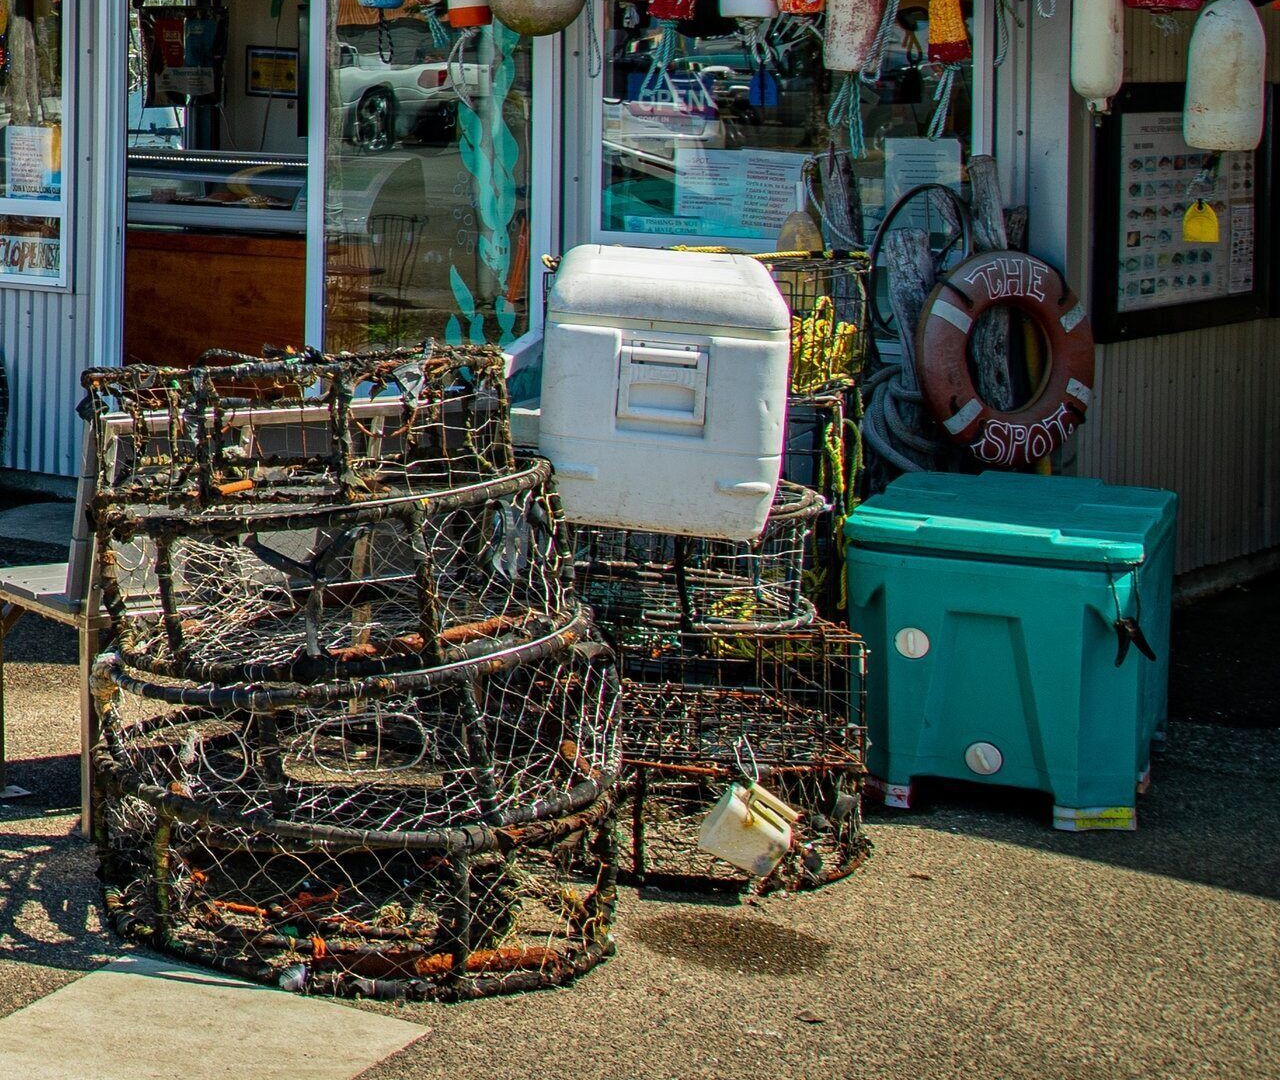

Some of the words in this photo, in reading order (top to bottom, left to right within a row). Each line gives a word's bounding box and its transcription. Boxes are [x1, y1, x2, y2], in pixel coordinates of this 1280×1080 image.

[639, 88, 705, 111] OPEN
[964, 258, 1051, 302] THE
[970, 401, 1073, 466] SPOT
